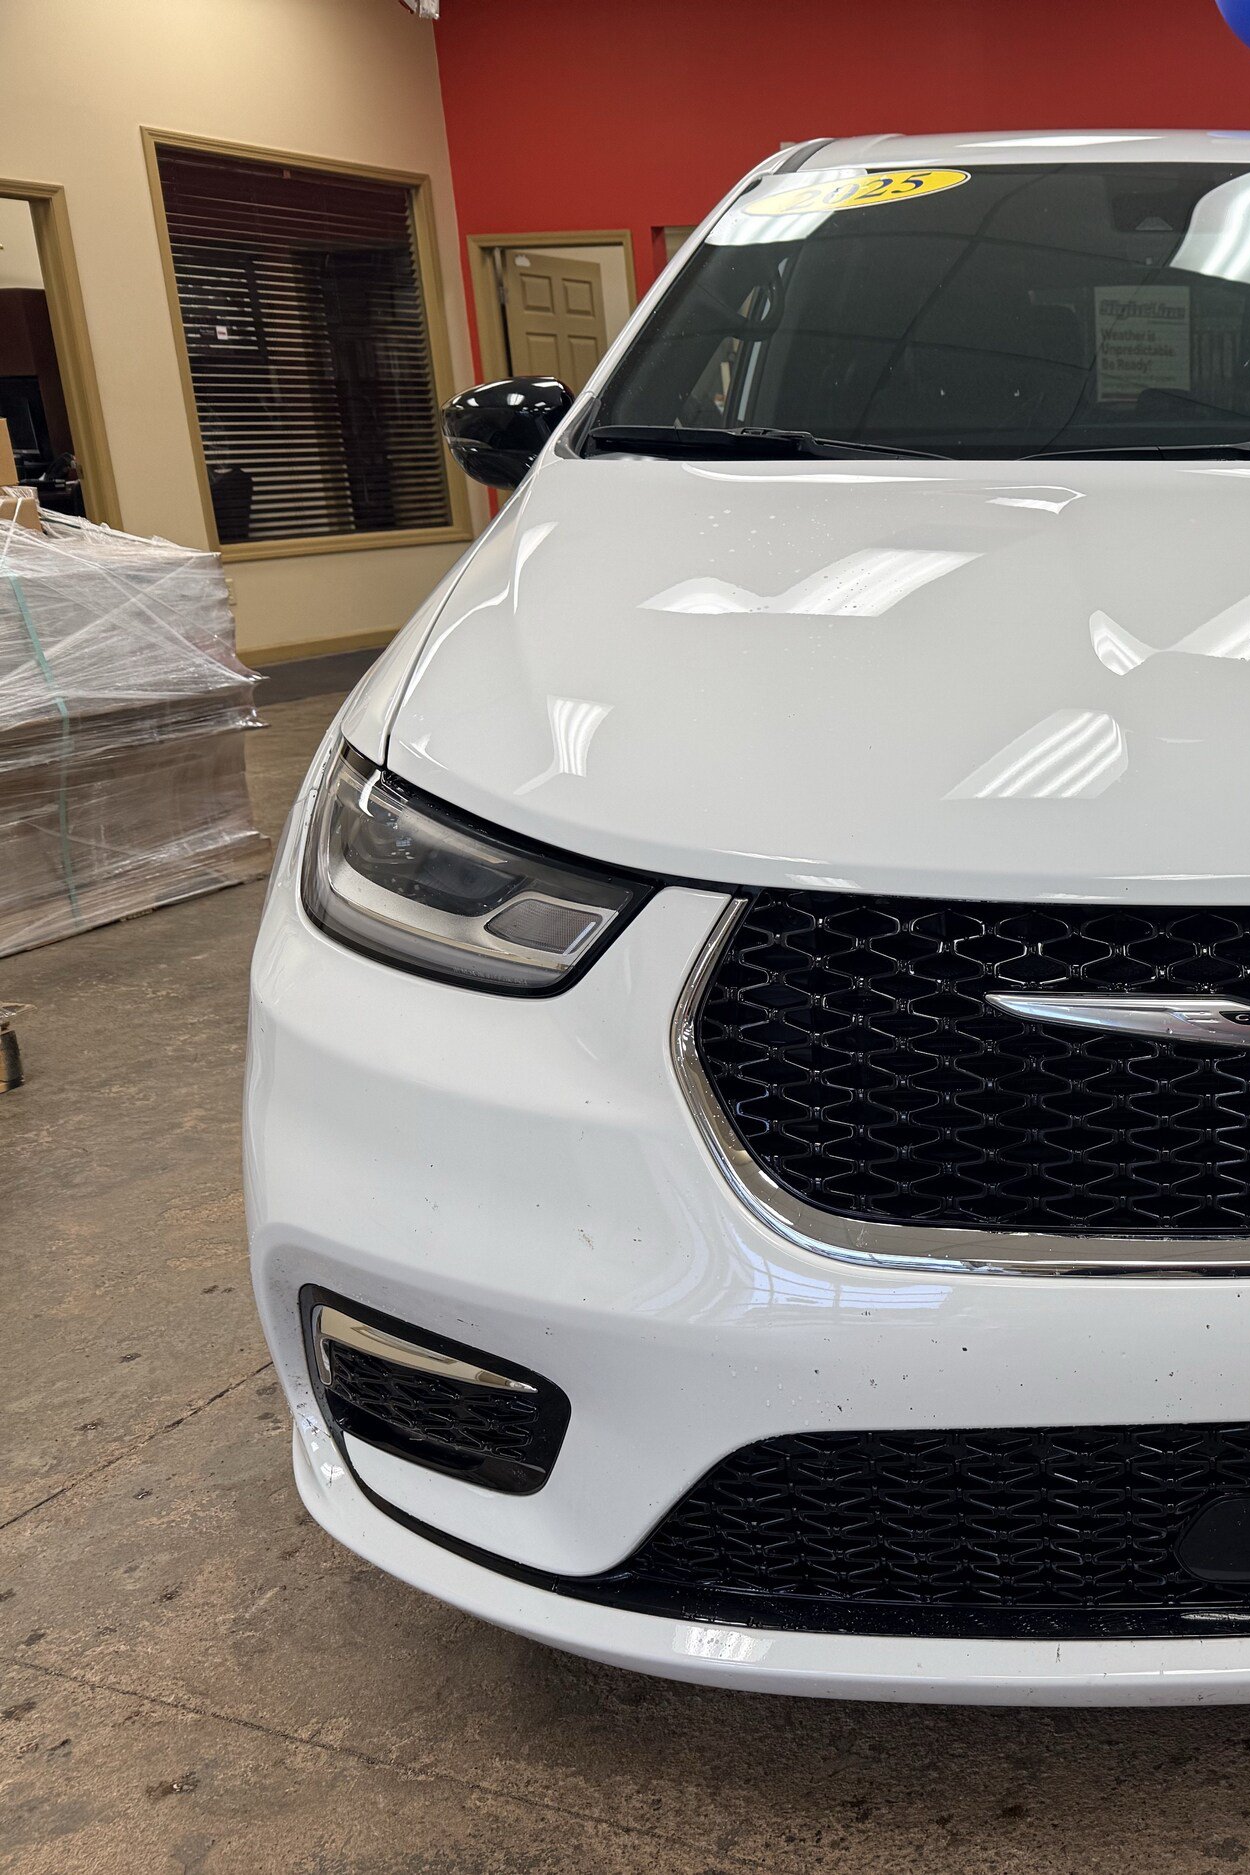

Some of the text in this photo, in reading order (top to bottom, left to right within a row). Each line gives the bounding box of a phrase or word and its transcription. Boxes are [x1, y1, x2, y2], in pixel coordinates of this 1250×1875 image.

[784, 172, 933, 211] 2025
[1101, 329, 1144, 340] Weather
[1101, 358, 1115, 371] Be
